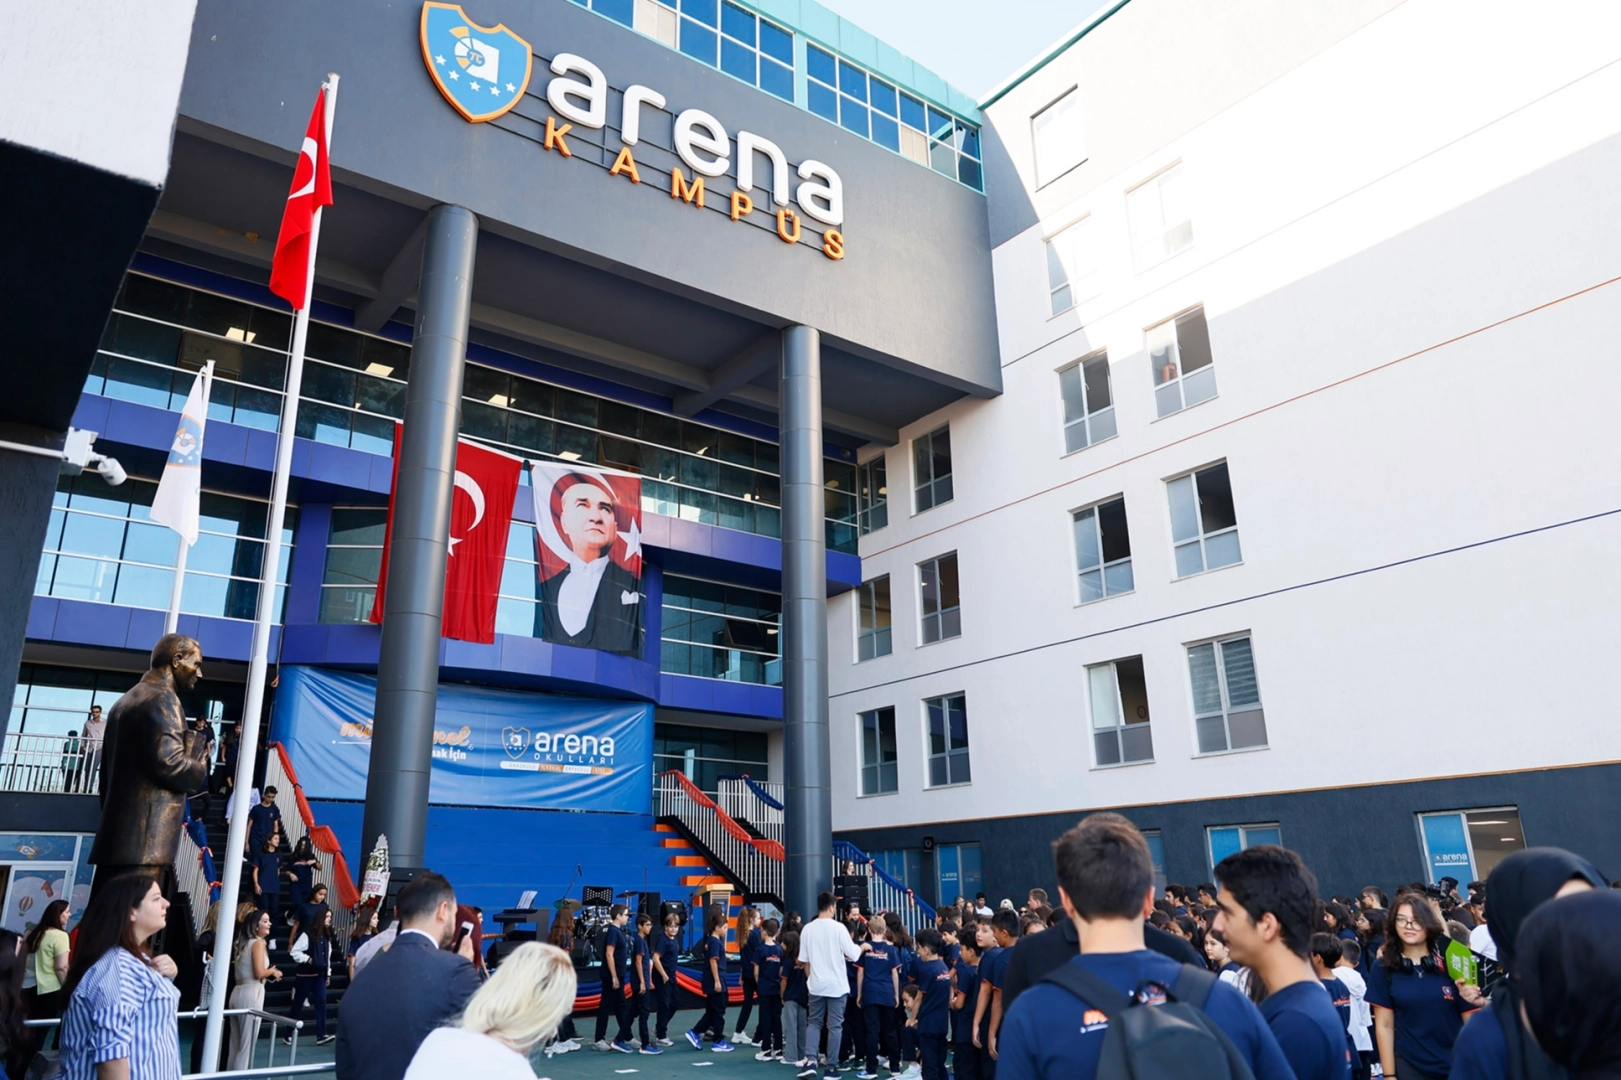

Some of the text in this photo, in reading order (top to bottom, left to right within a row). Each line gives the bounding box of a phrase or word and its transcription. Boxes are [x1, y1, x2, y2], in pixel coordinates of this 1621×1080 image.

[547, 52, 844, 226] arena
[544, 116, 845, 260] KAMPÜS
[534, 731, 615, 757] arena
[534, 752, 614, 765] OKULLARI
[1442, 853, 1468, 861] arena
